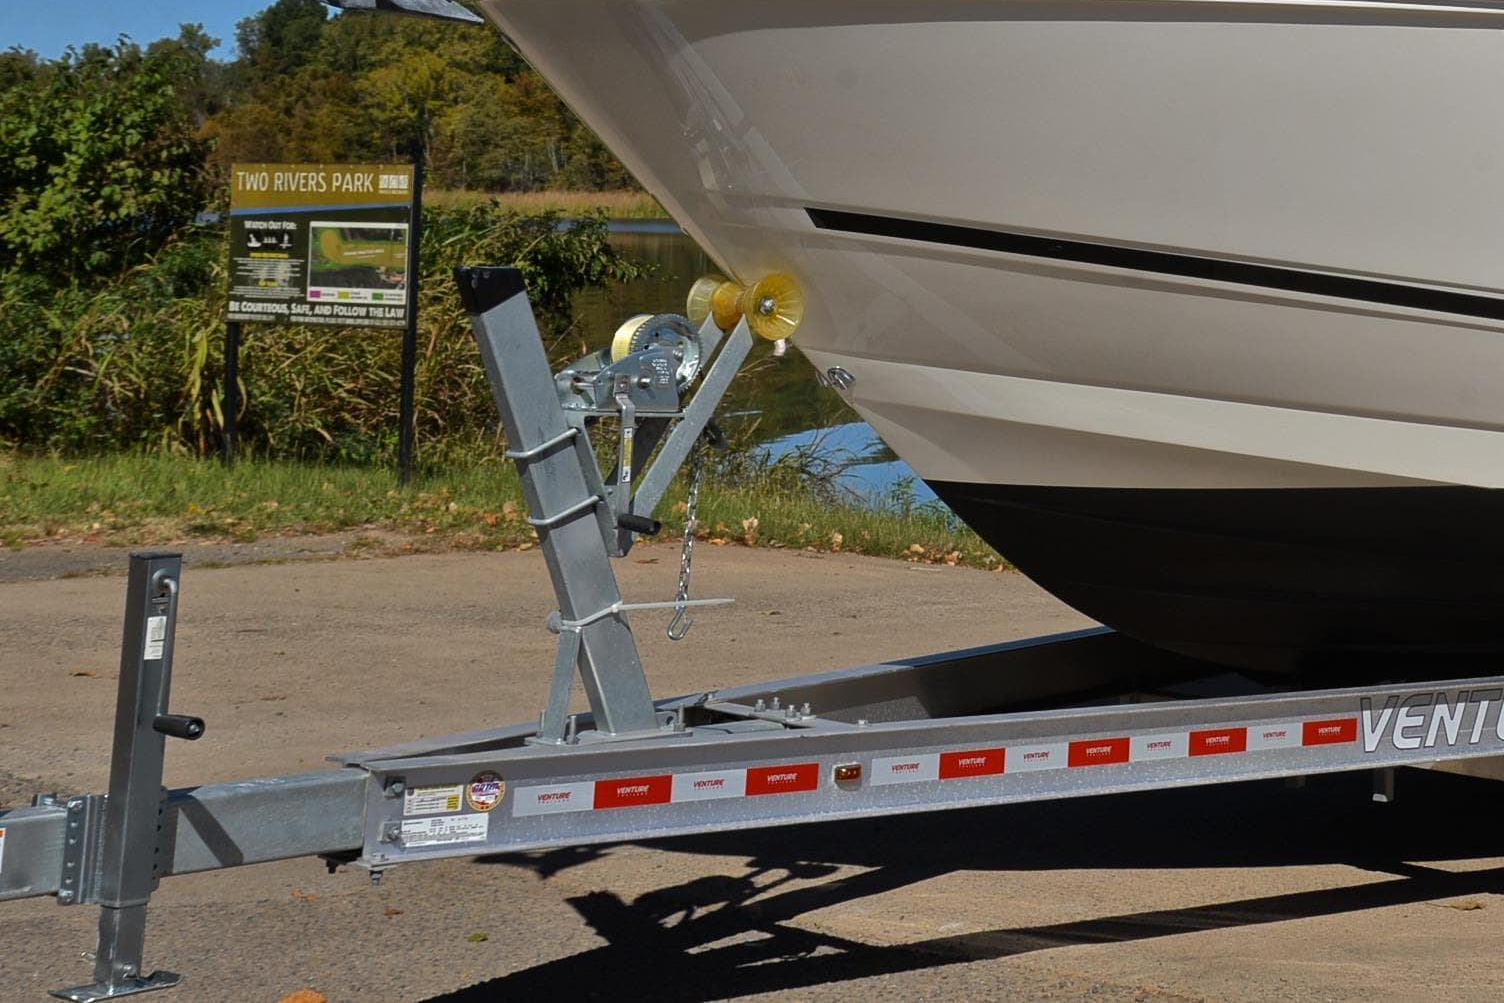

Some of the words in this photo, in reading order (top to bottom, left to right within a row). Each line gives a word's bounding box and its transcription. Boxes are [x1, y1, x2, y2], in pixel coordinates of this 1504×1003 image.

[236, 171, 269, 191] TWO
[274, 172, 327, 192] RIVERS
[332, 173, 374, 192] PARK
[244, 220, 268, 229] WATCH
[268, 221, 282, 229] OUT
[229, 301, 240, 312] BE
[314, 305, 331, 316] AND
[333, 305, 367, 316] FOLLOW
[369, 308, 383, 317] THE
[385, 308, 405, 318] LAW
[1262, 730, 1288, 738] VENTURE
[1318, 726, 1342, 734] VENTURE
[1146, 740, 1172, 748] VENTURE
[1205, 735, 1230, 744] VENTURE
[1086, 745, 1112, 754] VENTURE
[1023, 750, 1050, 760] VENTURE
[958, 756, 986, 766] VENTURE
[891, 762, 920, 772] VENTURE
[766, 772, 798, 782] VENTURE
[693, 778, 725, 788] VENTURE
[616, 784, 650, 794] VENTURE
[537, 791, 572, 800] VENTURE
